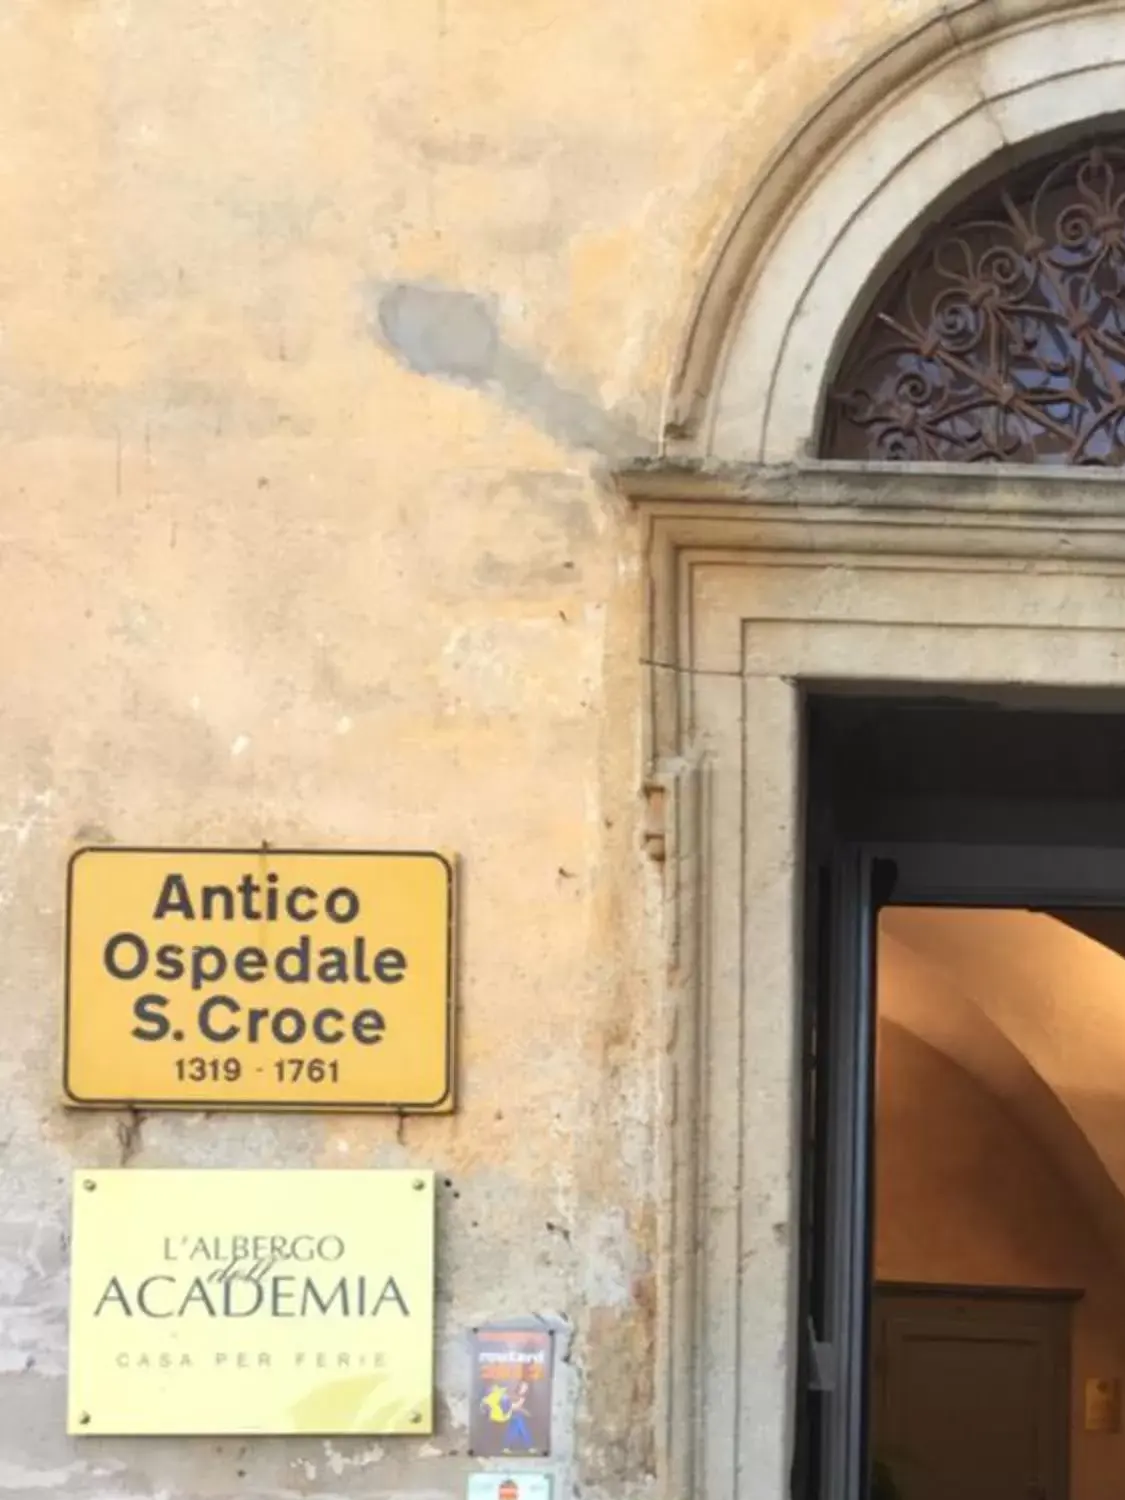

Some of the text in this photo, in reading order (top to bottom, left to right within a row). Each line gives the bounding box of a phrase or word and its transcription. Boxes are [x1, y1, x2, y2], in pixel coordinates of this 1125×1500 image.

[153, 873, 361, 924] Antico
[103, 932, 408, 990] Ospedale
[130, 993, 387, 1045] S. Croce
[174, 1056, 243, 1083] 1319
[273, 1056, 340, 1084] 1761
[162, 1235, 346, 1262] L'ALBERGO
[93, 1274, 411, 1318] ACADEMIA
[115, 1351, 389, 1368] CASA PER FERIE
